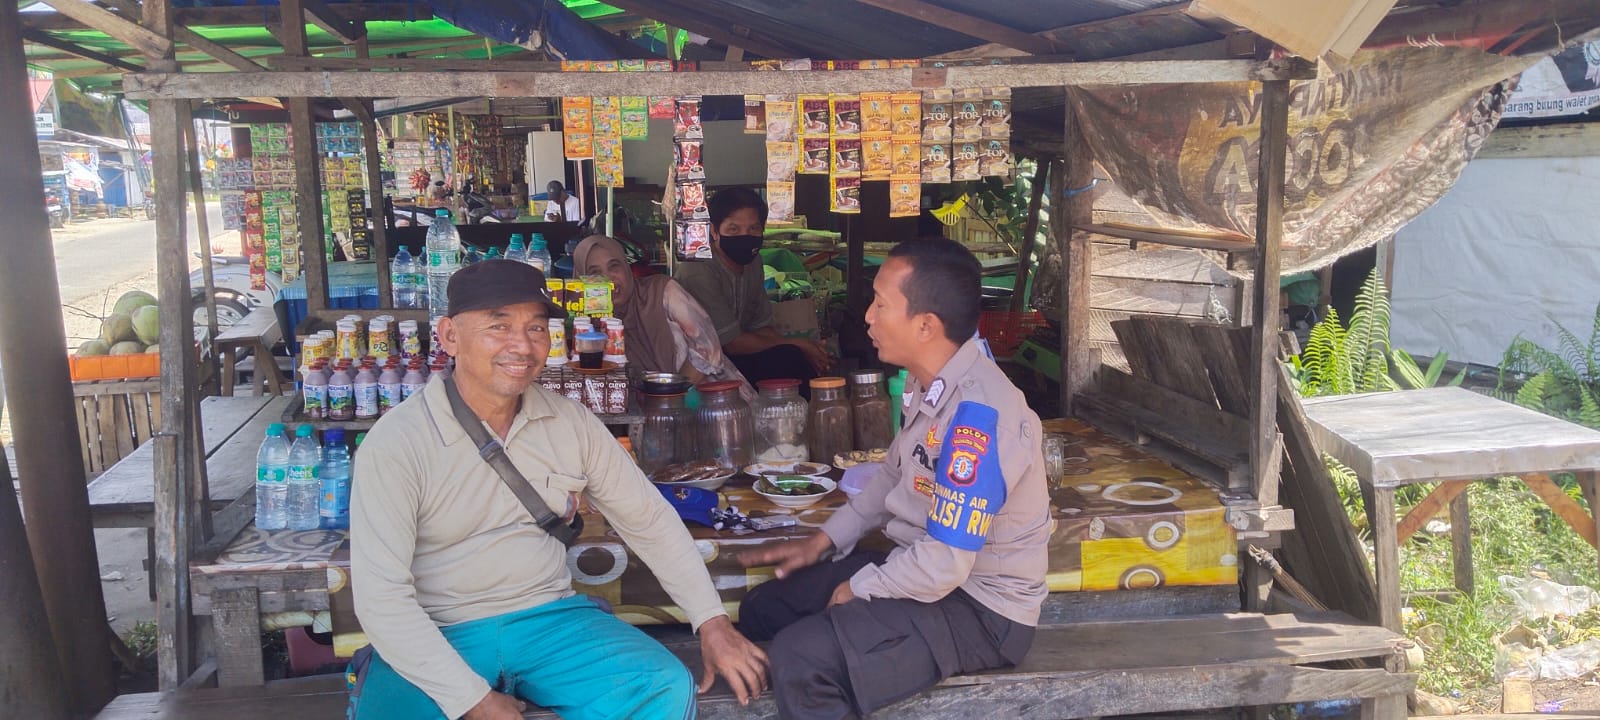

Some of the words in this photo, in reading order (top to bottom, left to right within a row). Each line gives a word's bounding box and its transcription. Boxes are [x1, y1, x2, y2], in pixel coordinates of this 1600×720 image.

[804, 101, 829, 110] ABC
[837, 101, 860, 110] ABC
[929, 112, 949, 121] TOP
[959, 112, 979, 120] TOP
[986, 109, 1006, 118] TOP
[837, 140, 860, 148] ABC
[926, 153, 948, 162] TOP
[959, 151, 979, 160] TOP
[986, 149, 1005, 157] TOP
[837, 178, 860, 186] ABC
[956, 428, 987, 442] POLDA
[969, 496, 988, 511] AIR
[966, 510, 995, 538] RW
